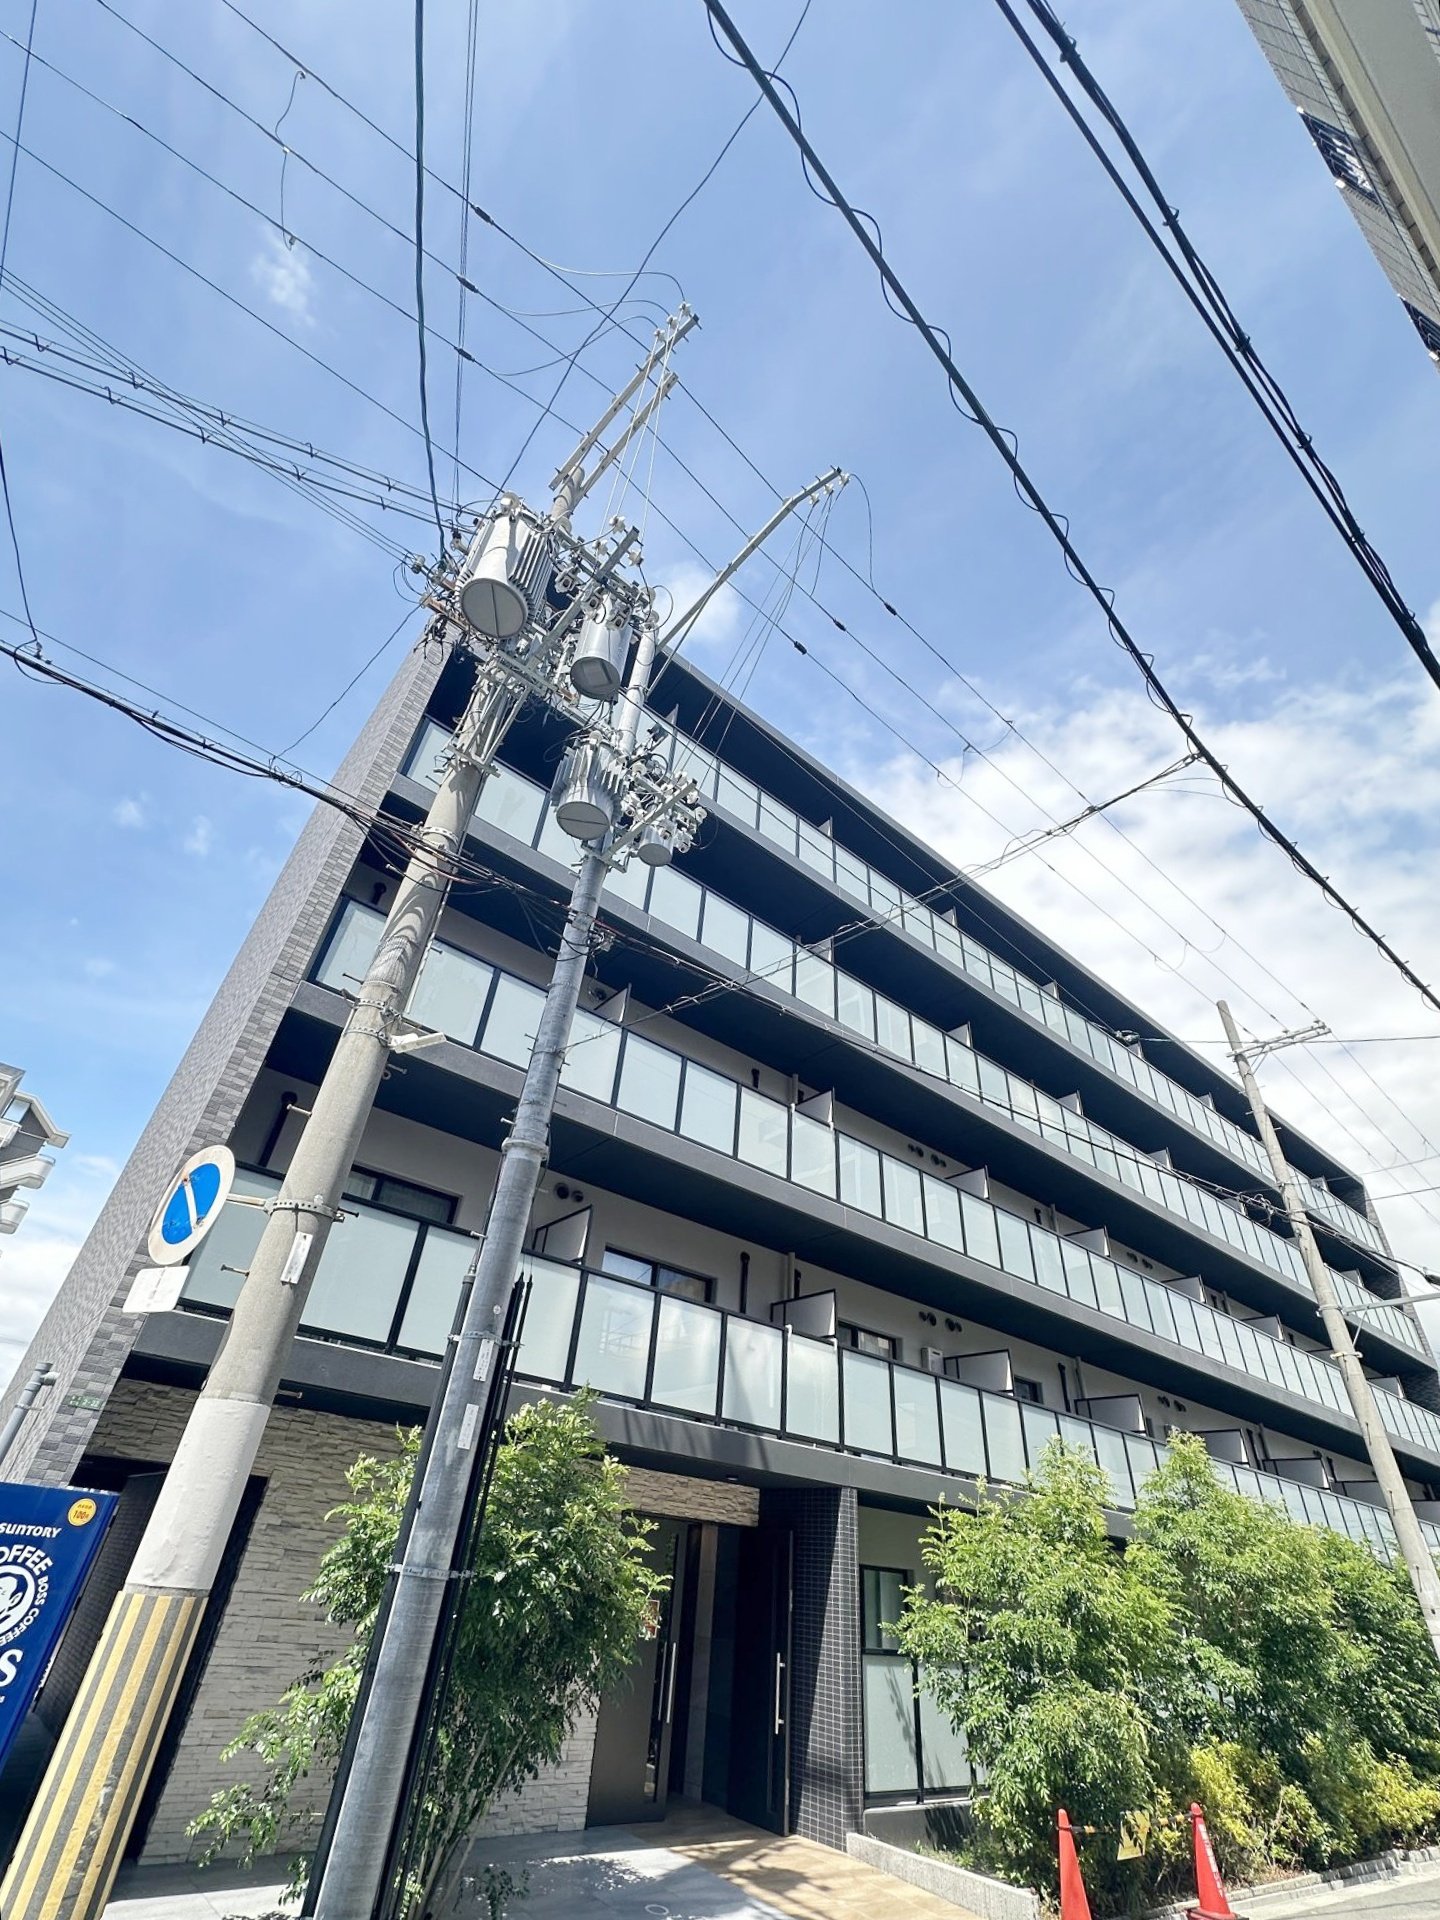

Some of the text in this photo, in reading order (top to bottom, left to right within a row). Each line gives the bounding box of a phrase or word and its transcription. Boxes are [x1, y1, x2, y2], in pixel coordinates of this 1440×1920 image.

[0, 1544, 54, 1576] OFFEE
[0, 1575, 49, 1647] BOSS COFFEE
